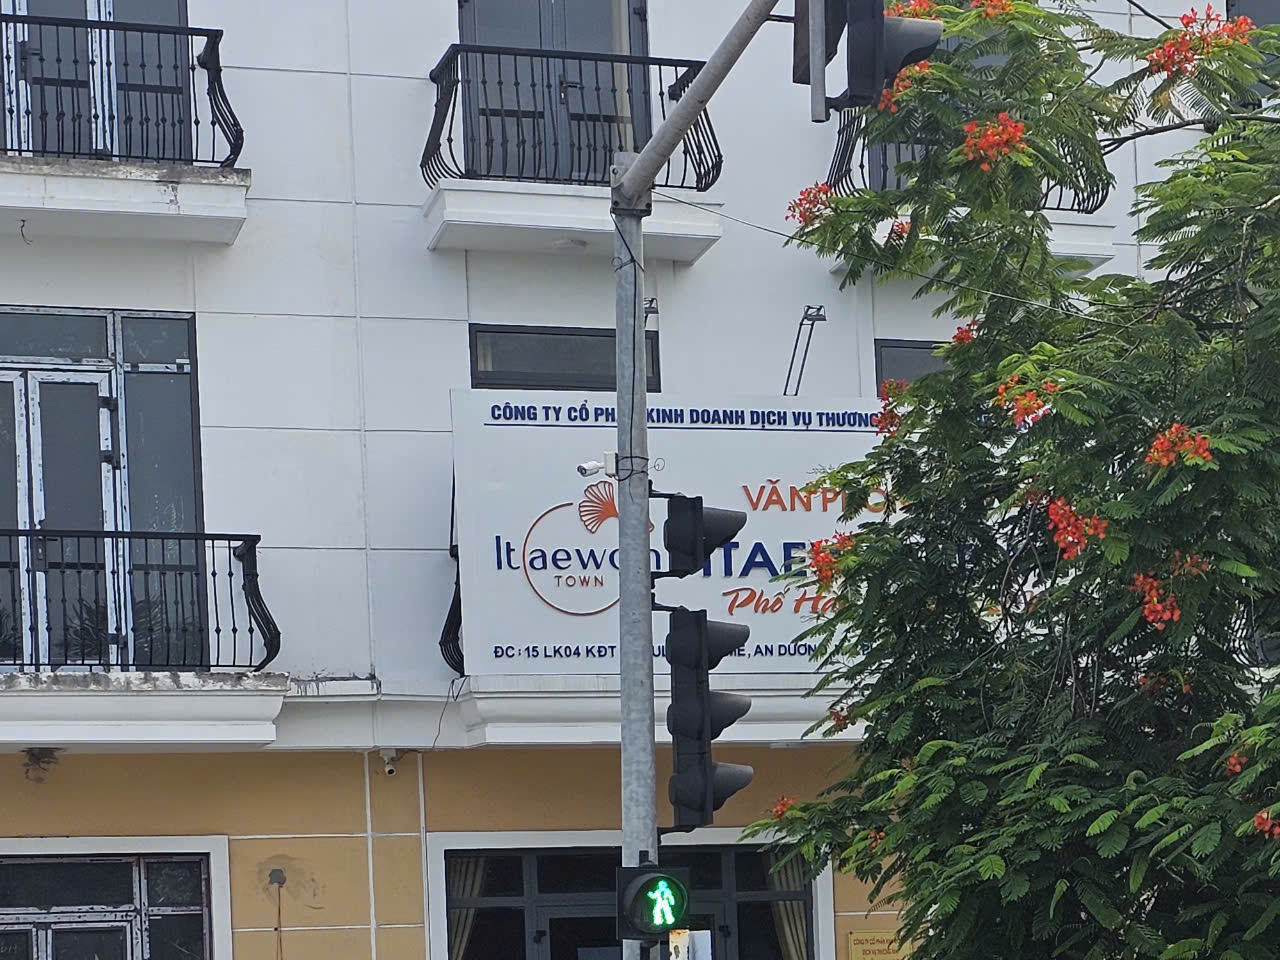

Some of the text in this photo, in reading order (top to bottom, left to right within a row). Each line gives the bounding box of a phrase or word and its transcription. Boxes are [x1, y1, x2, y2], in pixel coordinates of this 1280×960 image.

[491, 402, 537, 421] CÔNG
[542, 405, 562, 421] TY
[567, 400, 590, 421] CỔ
[594, 407, 617, 422] PH
[647, 408, 684, 424] KINH
[690, 408, 745, 425] DOANH
[750, 410, 787, 429] DỊCH
[792, 411, 812, 430] VỤ
[742, 479, 812, 512] VĂN
[554, 575, 604, 588] TOWN
[722, 586, 791, 616] Phố
[544, 646, 581, 658] LK04
[585, 646, 617, 658] KĐT
[754, 645, 774, 657] AN
[778, 643, 817, 657] DƯƠN
